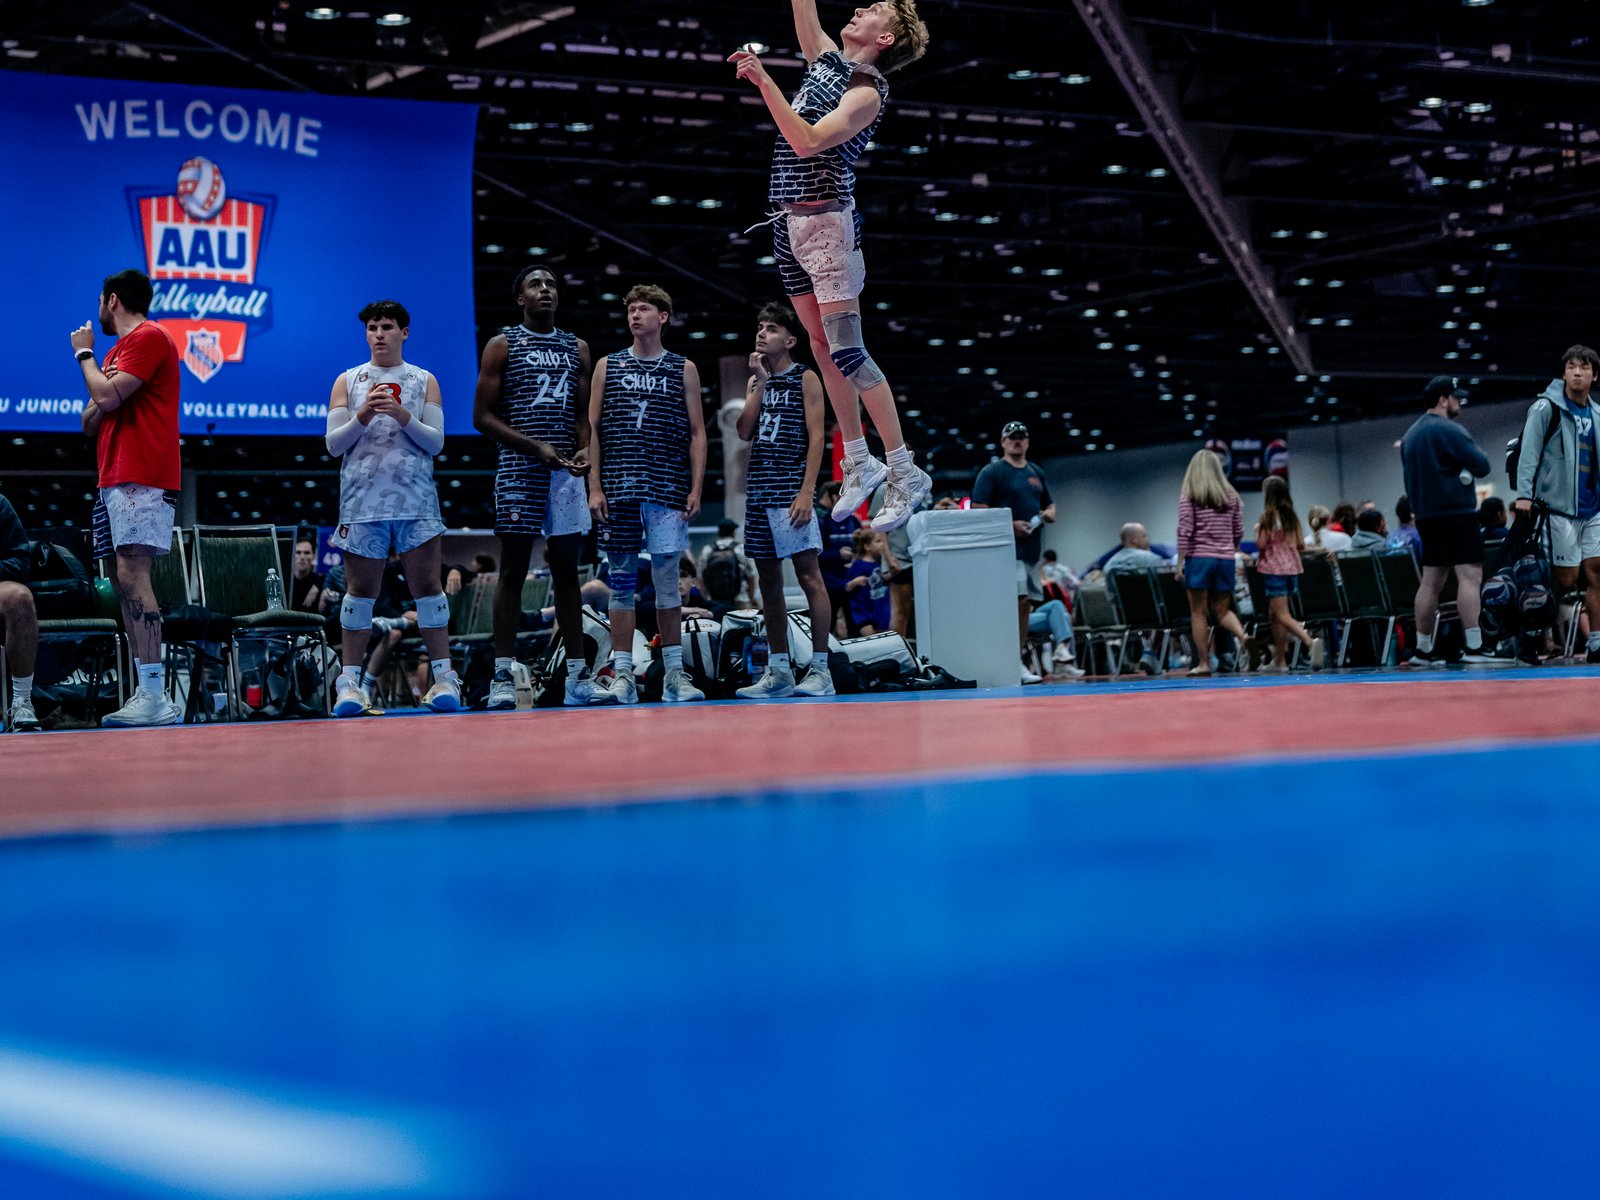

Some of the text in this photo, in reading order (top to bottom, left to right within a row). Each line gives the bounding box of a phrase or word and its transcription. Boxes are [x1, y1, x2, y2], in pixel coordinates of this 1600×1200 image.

[74, 99, 323, 157] WELCOME
[157, 228, 247, 270] AAU
[183, 402, 289, 419] VOLLEYBALL
[531, 370, 570, 410] 24
